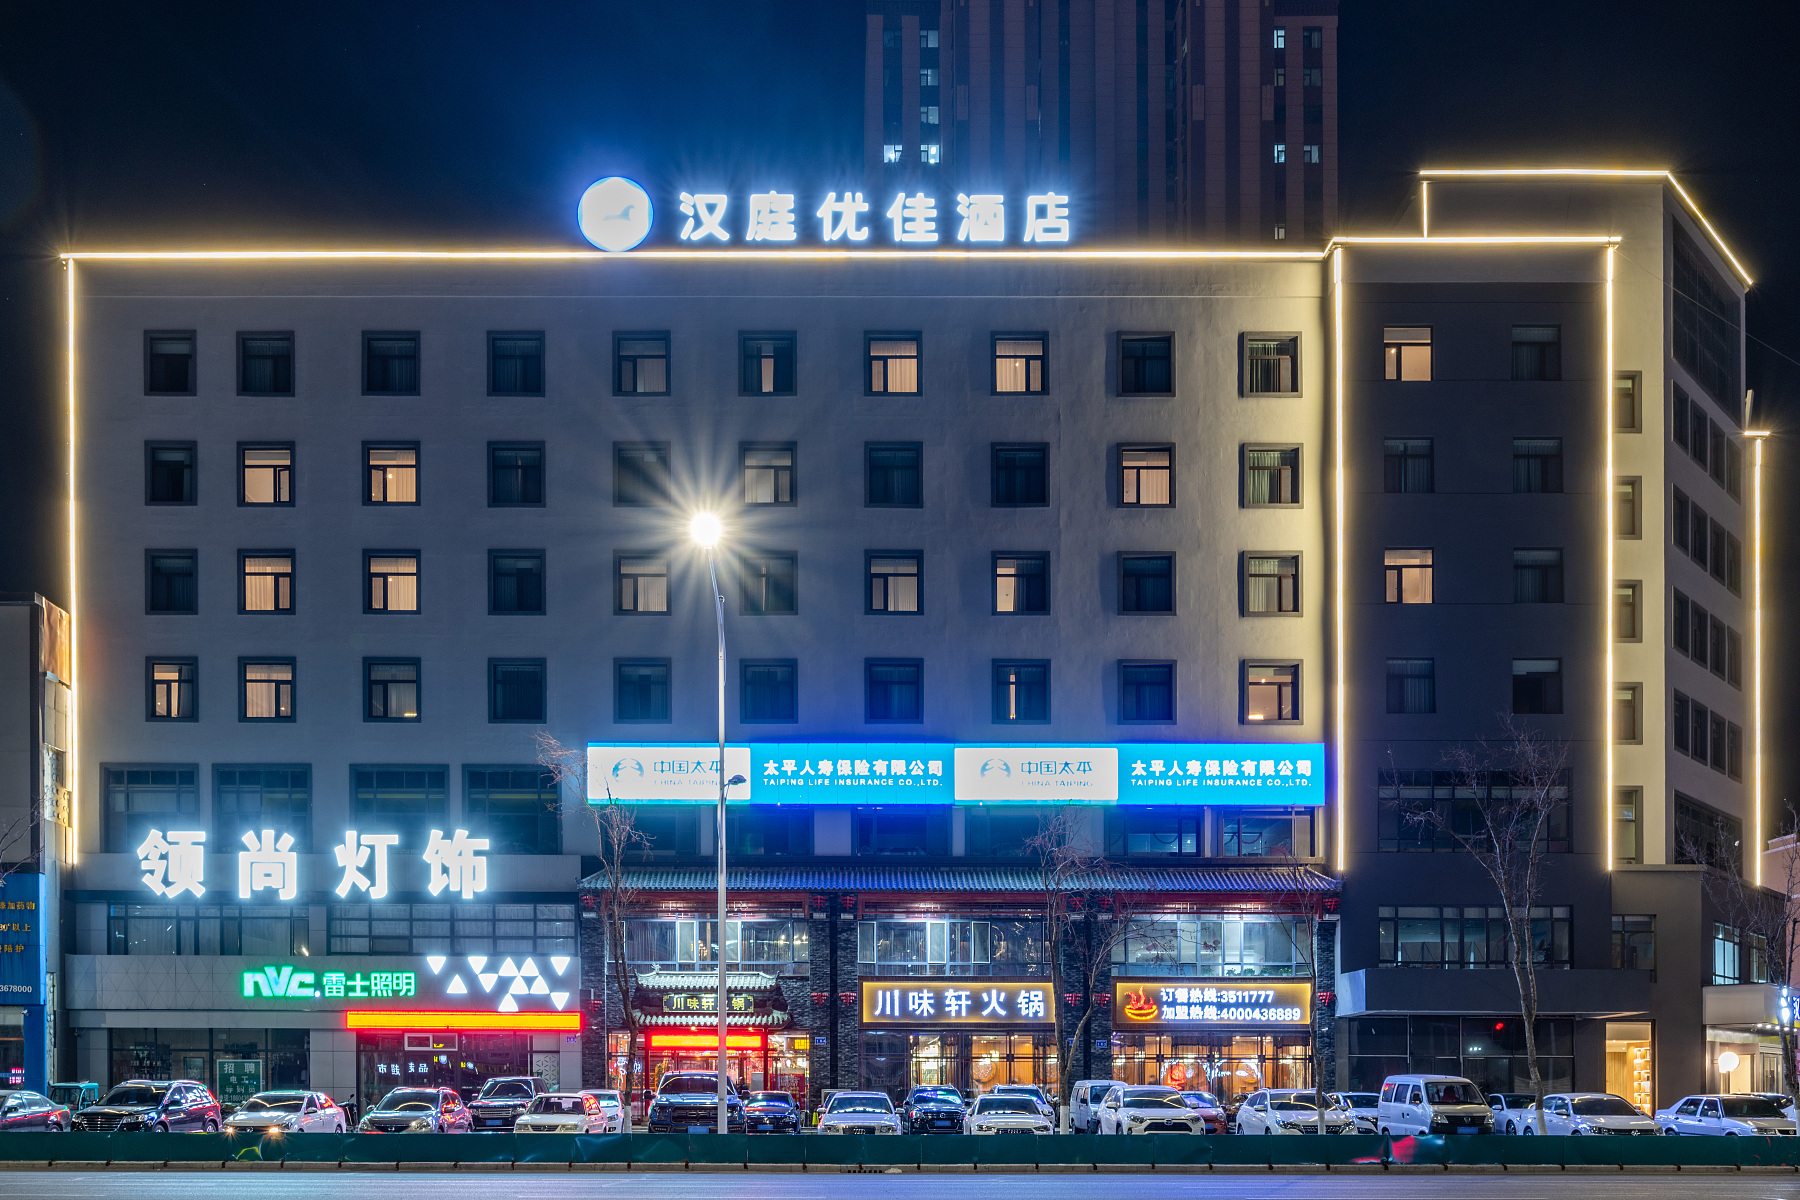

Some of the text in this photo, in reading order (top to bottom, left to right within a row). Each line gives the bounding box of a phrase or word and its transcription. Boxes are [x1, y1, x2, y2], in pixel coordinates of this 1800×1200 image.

[679, 190, 1069, 242] 汉庭优佳酒店
[763, 759, 942, 776] 太平人寿保险有限公司
[1021, 760, 1093, 775] 中国太平
[1131, 759, 1312, 776] 太平人寿保险有限公司
[763, 778, 943, 787] TAIPING LIFE INSURANCE CO.,LTD.
[1131, 778, 1312, 787] TAIPING LIFE INSURANCE CO.,LTD.
[137, 829, 490, 900] 领尚灯饰
[0, 944, 24, 953] 陪护
[323, 972, 416, 997] 雷士照明
[673, 997, 745, 1011] 川味轩锅
[874, 989, 1045, 1017] 川味轩火锅
[224, 1062, 255, 1074] 招聘
[230, 1075, 248, 1084] 电工
